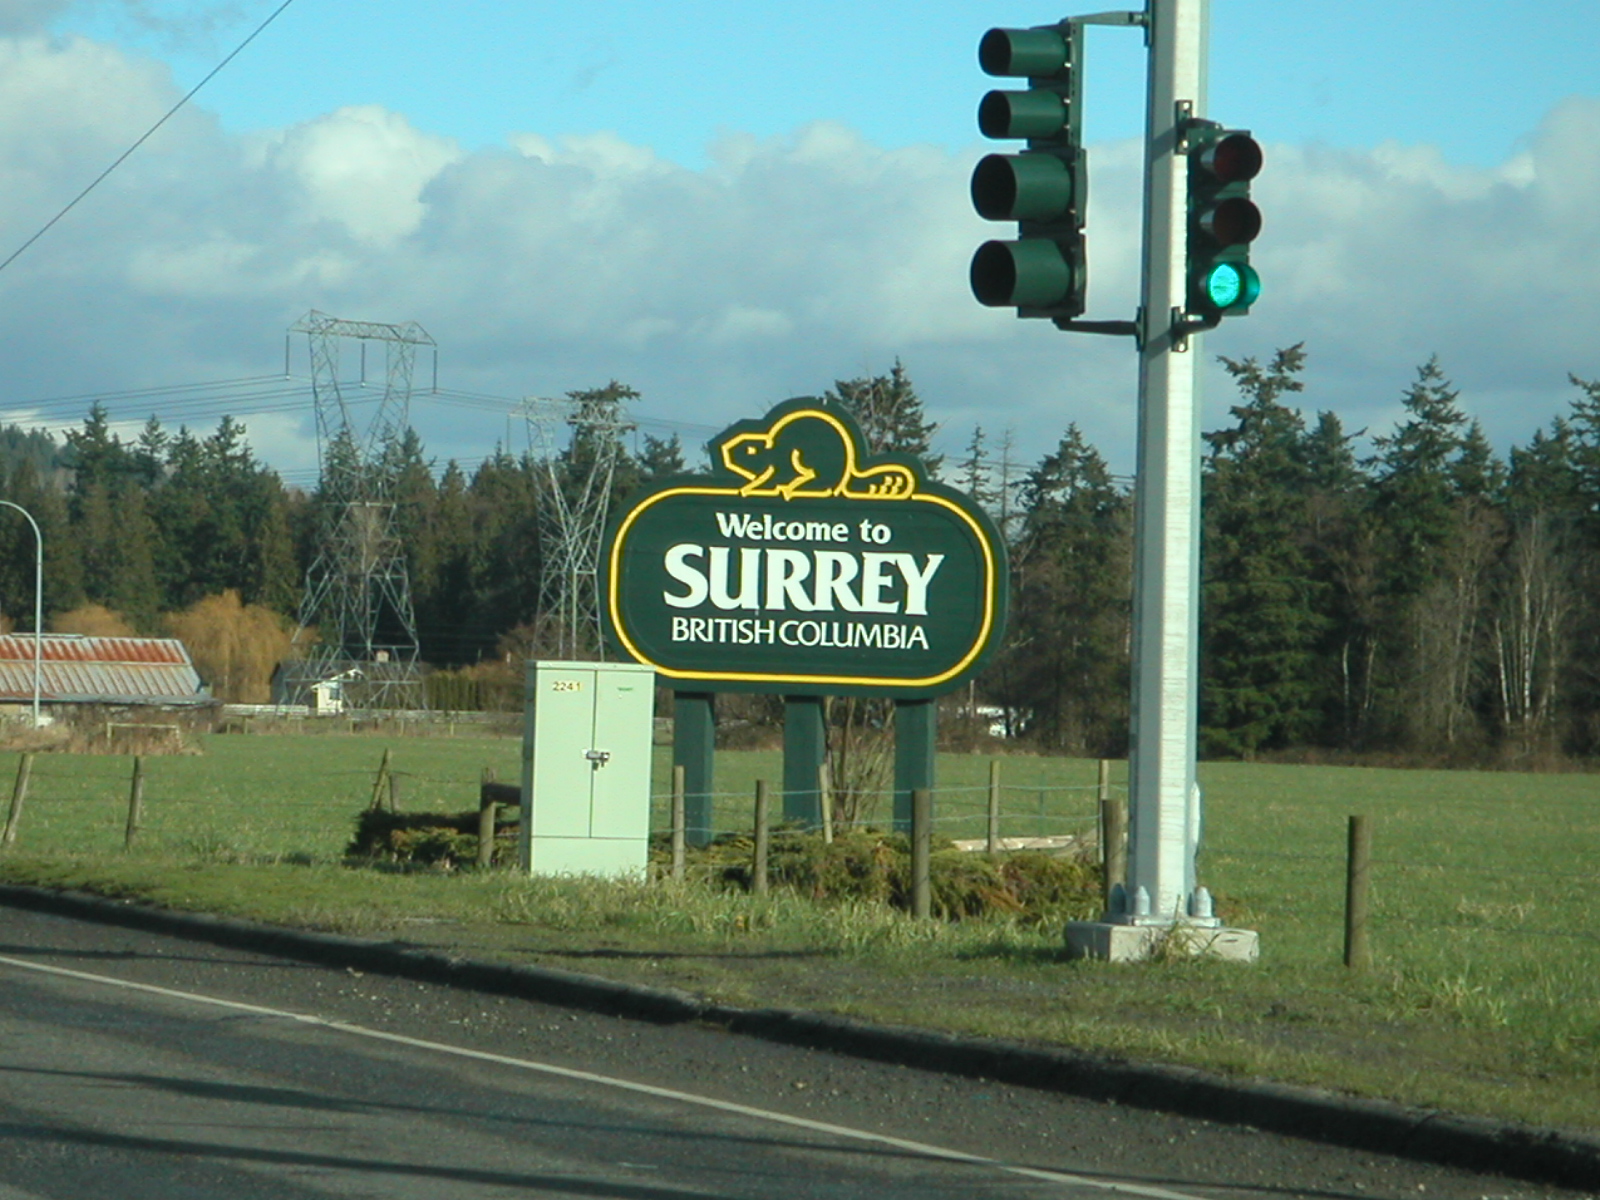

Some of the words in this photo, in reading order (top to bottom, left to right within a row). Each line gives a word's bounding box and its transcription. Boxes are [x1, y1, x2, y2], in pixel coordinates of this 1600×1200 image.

[715, 512, 849, 542] Welcome
[859, 518, 892, 544] to
[663, 543, 945, 616] SURREY
[671, 616, 775, 645] BRITISH
[778, 619, 930, 650] COLUMBIA
[552, 681, 581, 692] 2241
